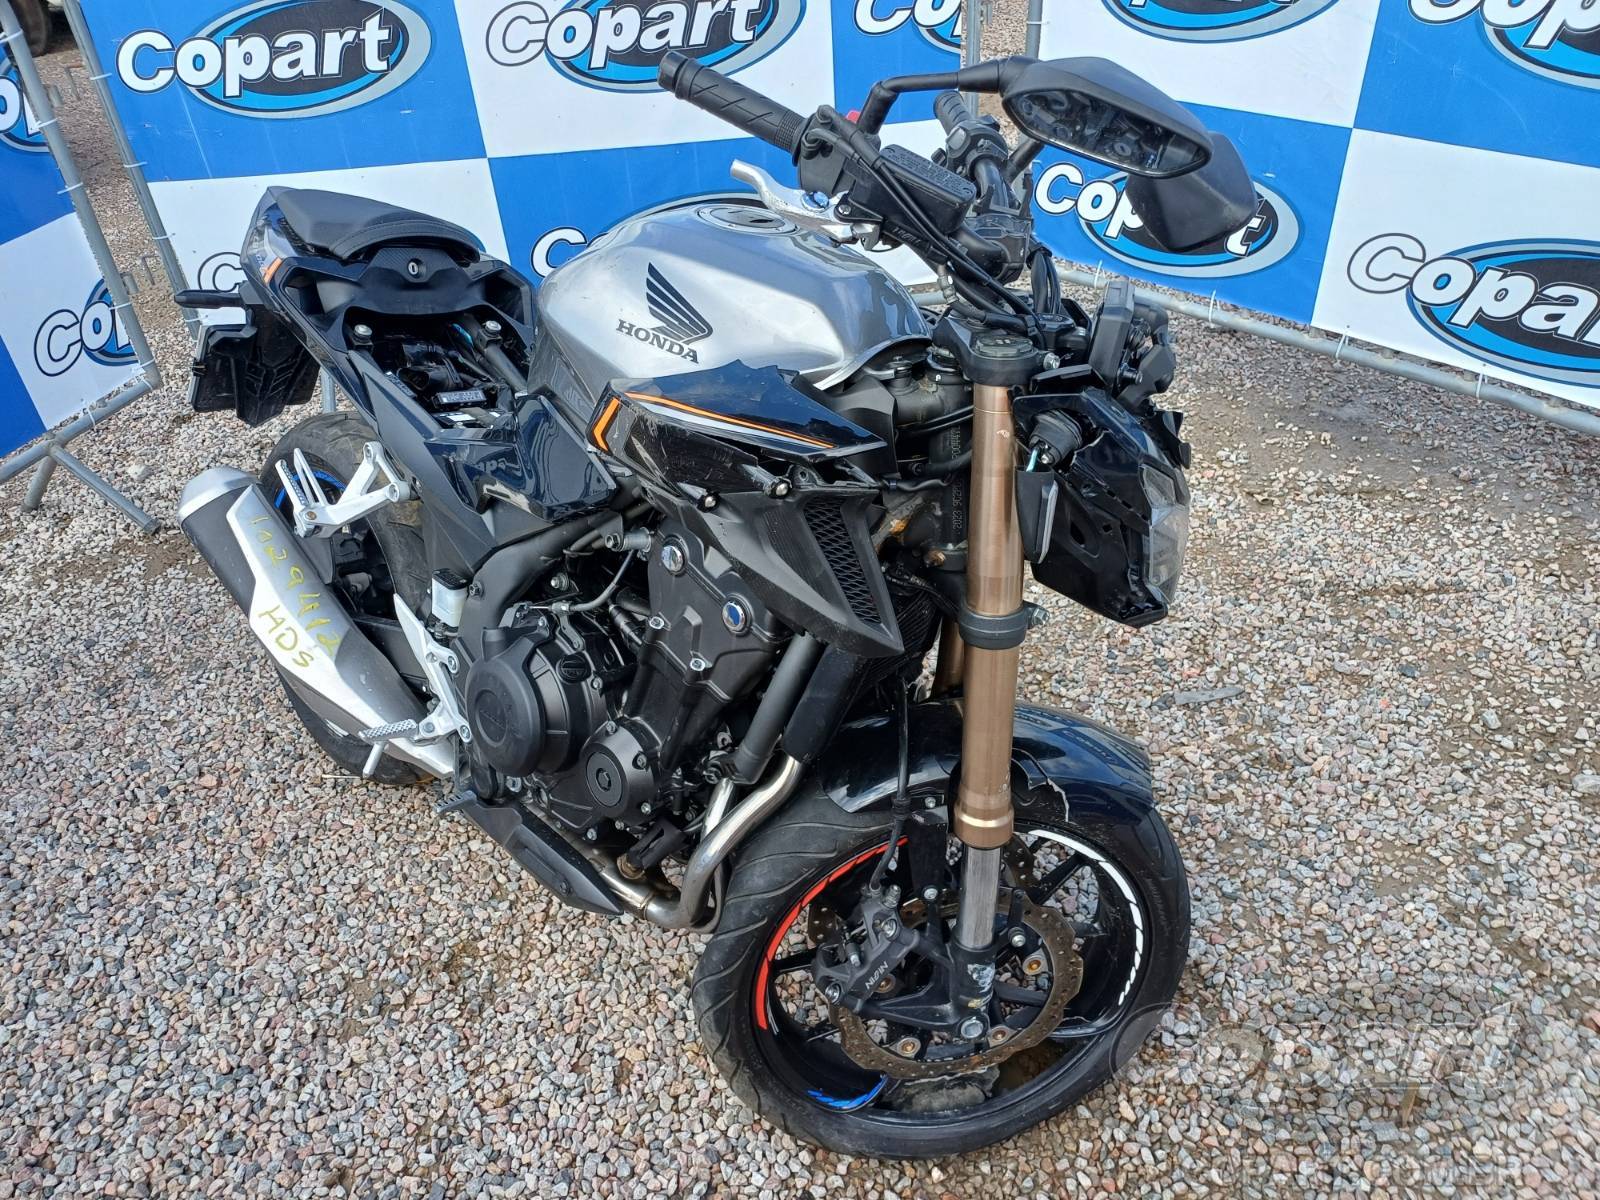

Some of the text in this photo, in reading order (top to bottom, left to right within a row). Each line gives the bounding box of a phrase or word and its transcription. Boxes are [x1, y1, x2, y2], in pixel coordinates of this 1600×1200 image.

[116, 8, 393, 98] Copart
[485, 0, 763, 71] Copart
[1346, 231, 1600, 345] Copa
[615, 318, 699, 364] HONDA
